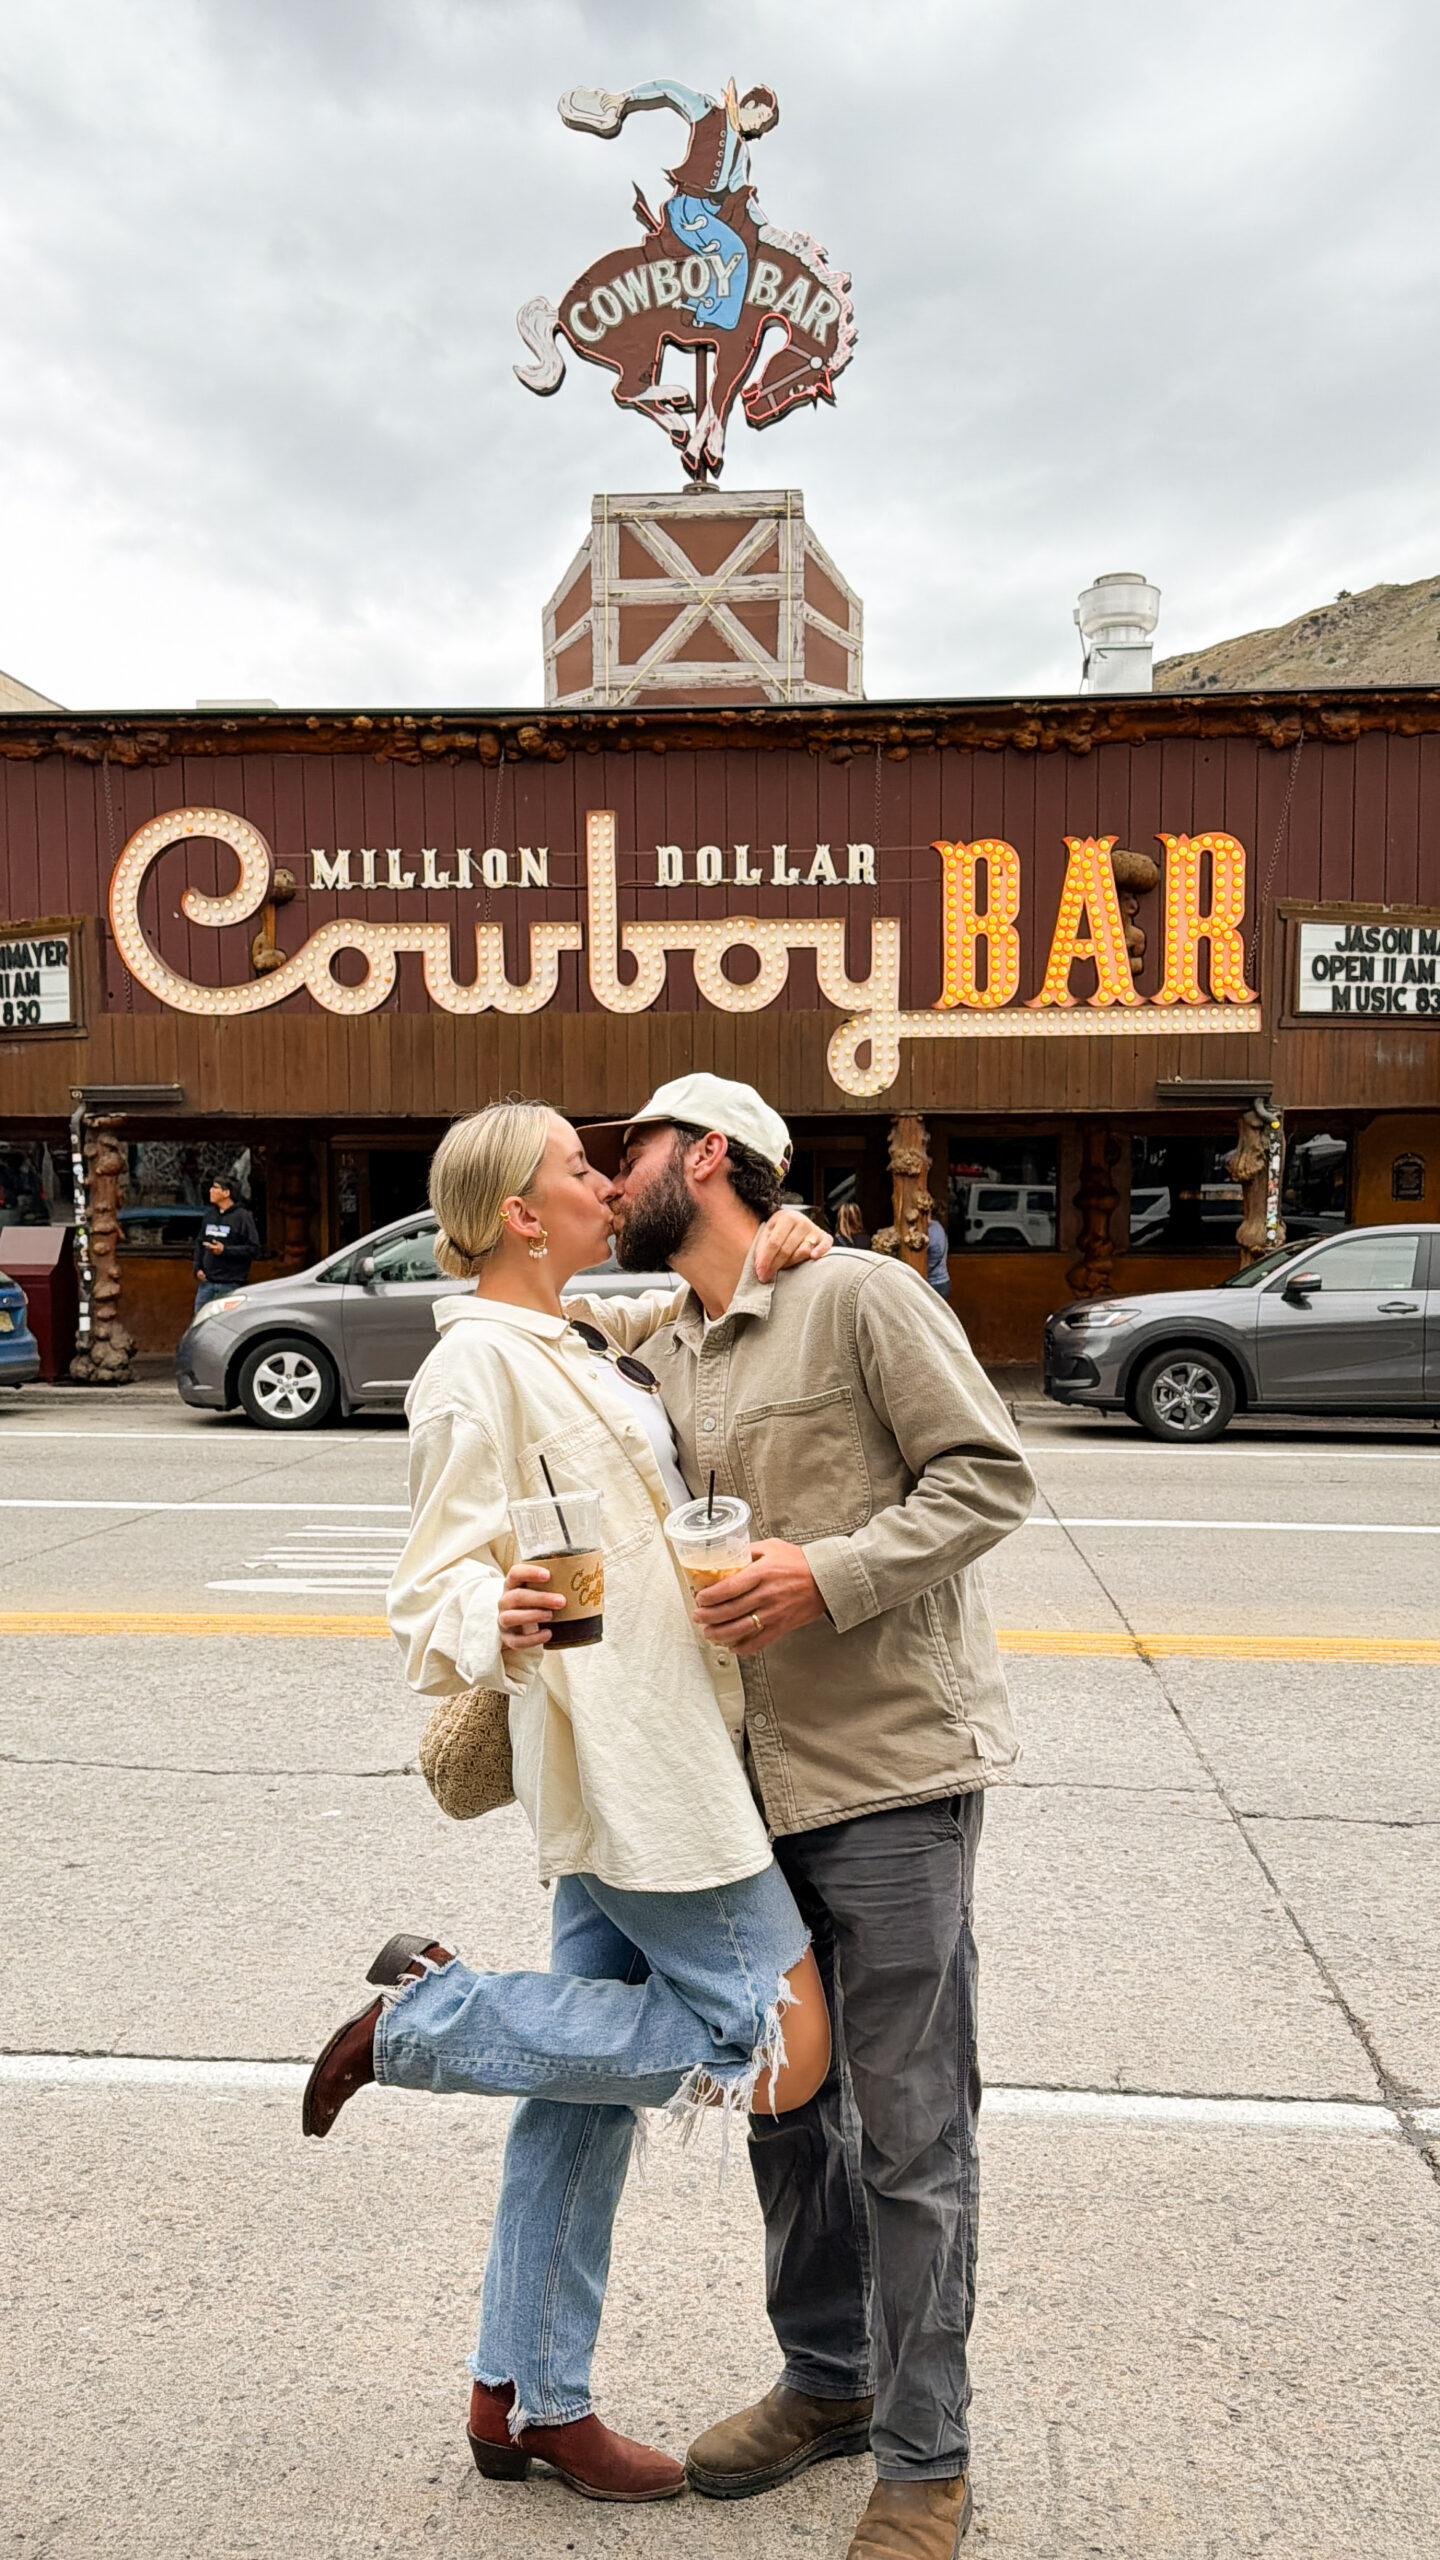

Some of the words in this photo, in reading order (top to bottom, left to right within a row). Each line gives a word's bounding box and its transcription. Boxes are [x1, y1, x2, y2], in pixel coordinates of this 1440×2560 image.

[569, 253, 745, 342] COWBOY
[746, 260, 841, 343] BAR
[310, 847, 549, 890] MILLION
[655, 843, 877, 886] DOLLAR
[109, 806, 901, 1097] Cowboy
[930, 831, 1261, 1009] BAR
[1335, 925, 1413, 955] JASON
[1312, 954, 1375, 982] OPEN
[1402, 957, 1436, 984] AM
[13, 971, 40, 998] AM
[1332, 985, 1408, 1012] MUSIC
[3, 999, 41, 1026] 830
